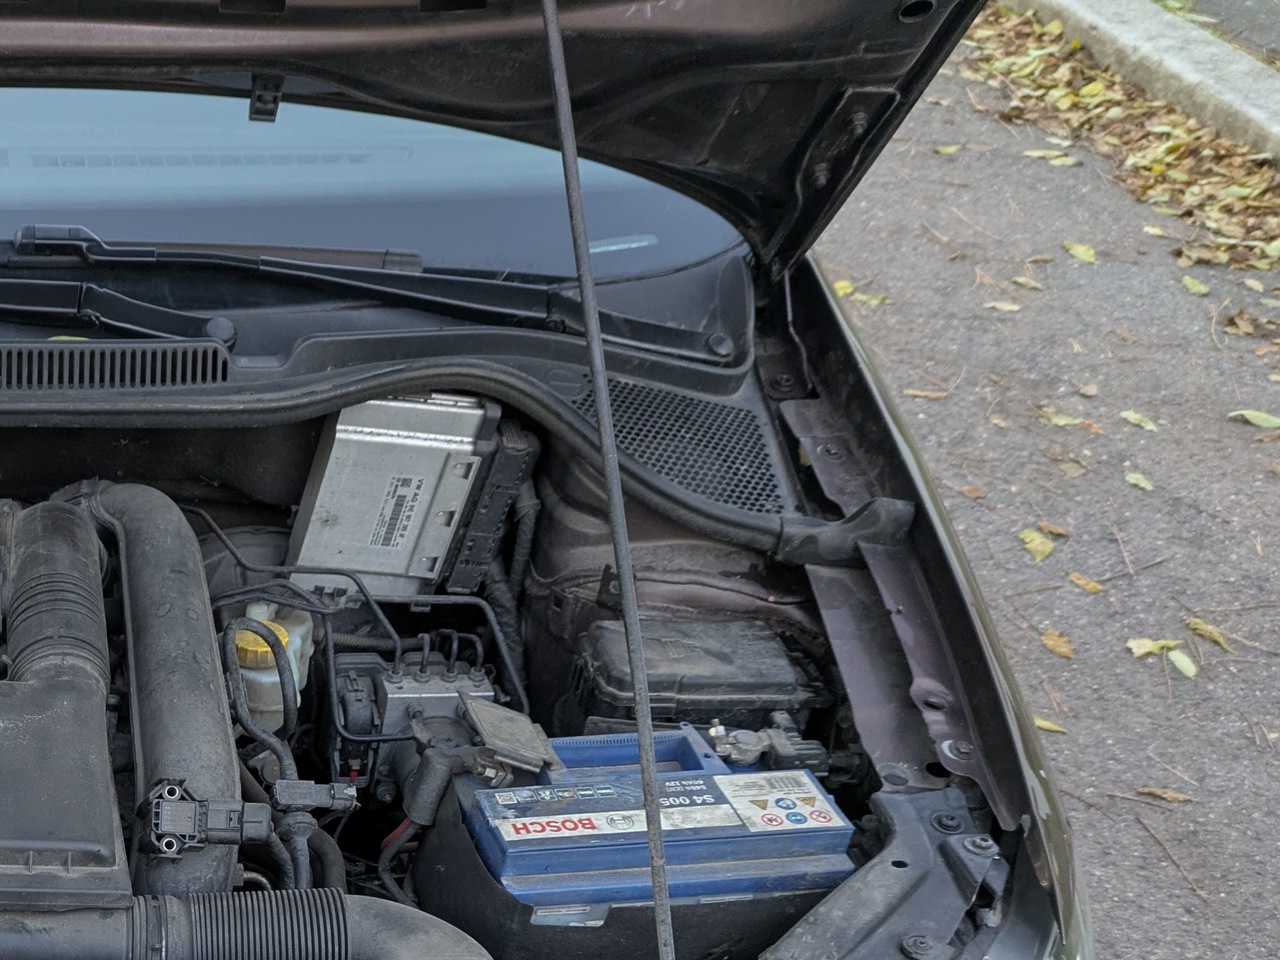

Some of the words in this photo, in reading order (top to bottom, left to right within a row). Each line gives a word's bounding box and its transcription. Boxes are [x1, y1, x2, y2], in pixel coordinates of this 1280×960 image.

[659, 796, 690, 806] 005
[692, 795, 715, 804] S4
[512, 817, 597, 835] BOSCH
